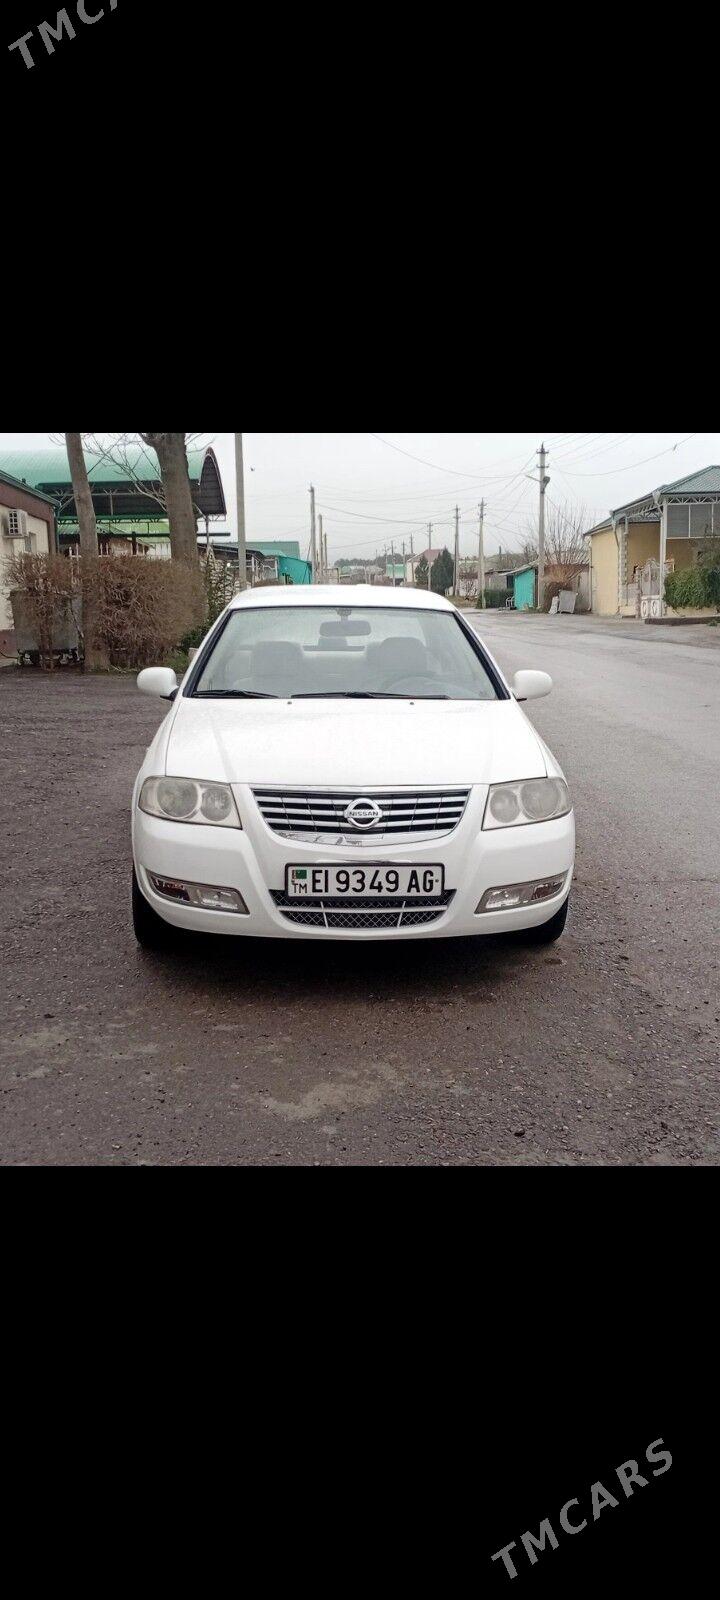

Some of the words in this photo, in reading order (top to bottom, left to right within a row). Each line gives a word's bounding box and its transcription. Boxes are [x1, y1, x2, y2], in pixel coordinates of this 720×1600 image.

[293, 883, 308, 894] TM
[312, 869, 329, 893] EI
[335, 869, 399, 893] 9349
[407, 869, 434, 893] AG
